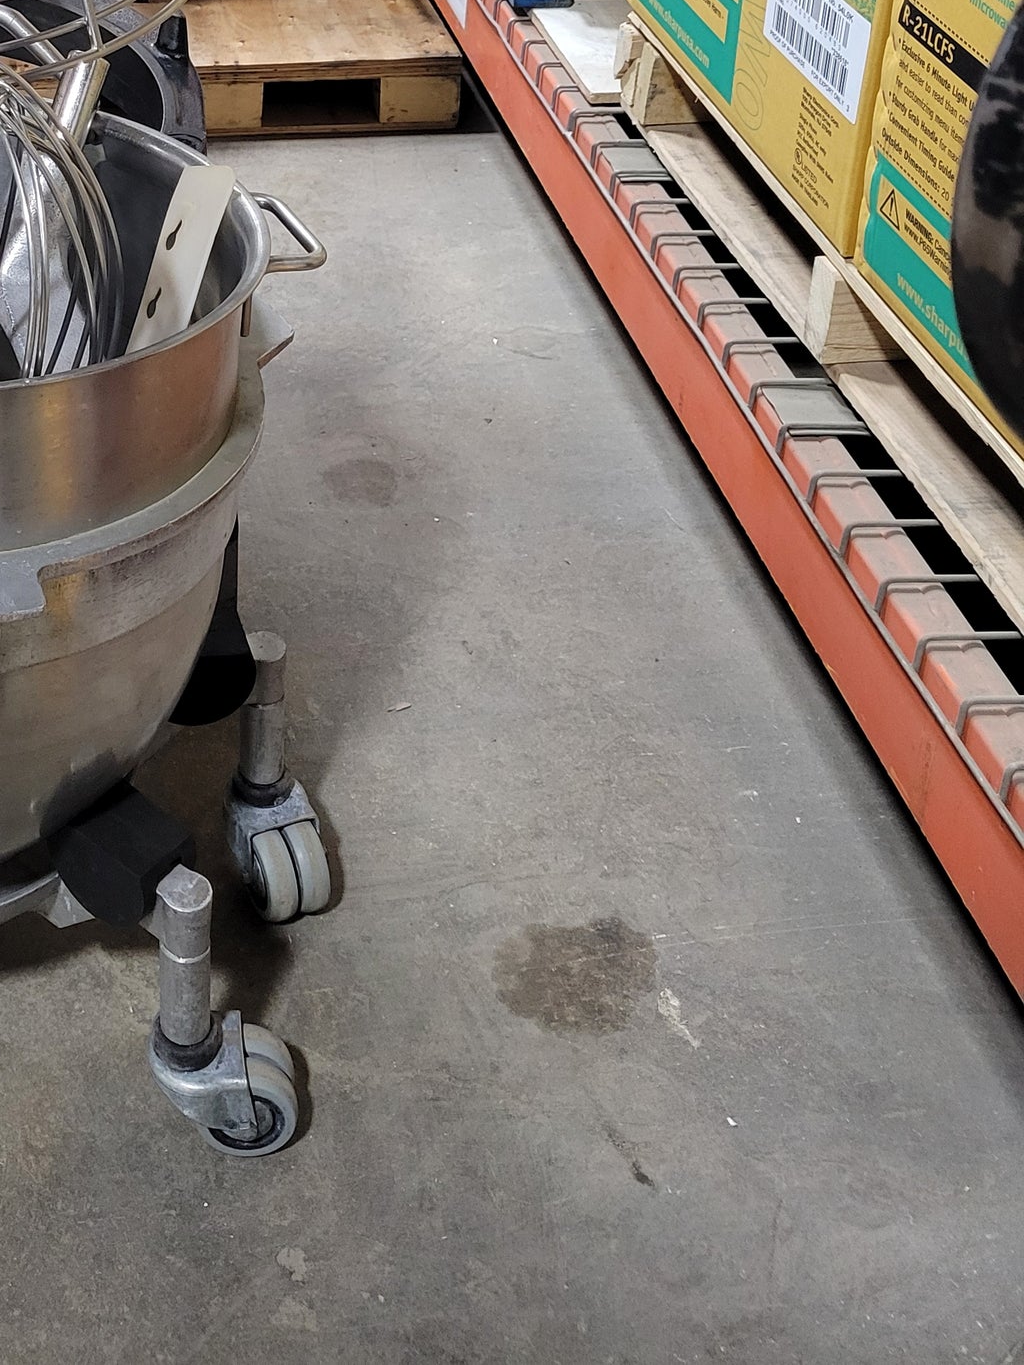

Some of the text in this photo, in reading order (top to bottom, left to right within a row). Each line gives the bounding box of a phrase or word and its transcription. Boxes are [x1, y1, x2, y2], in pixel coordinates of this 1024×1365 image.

[903, 5, 955, 64] R-21LCFS
[819, 78, 833, 94] EXPORT
[833, 93, 844, 106] ONLY
[899, 58, 957, 118] and easier to read than
[902, 42, 925, 68] Exclusive
[932, 66, 951, 91] Minute
[952, 80, 968, 107] Light
[892, 92, 907, 115] Sturdy
[908, 108, 920, 126] Grab
[921, 118, 938, 144] Handle
[939, 135, 947, 151] for
[904, 86, 934, 120] customizing
[935, 113, 950, 132] menu
[881, 128, 949, 201] Outside Dimensions: 20
[889, 112, 955, 182] Convenient Timing Guide
[905, 208, 933, 245] WARNING:
[897, 272, 969, 360] www.sharpu
